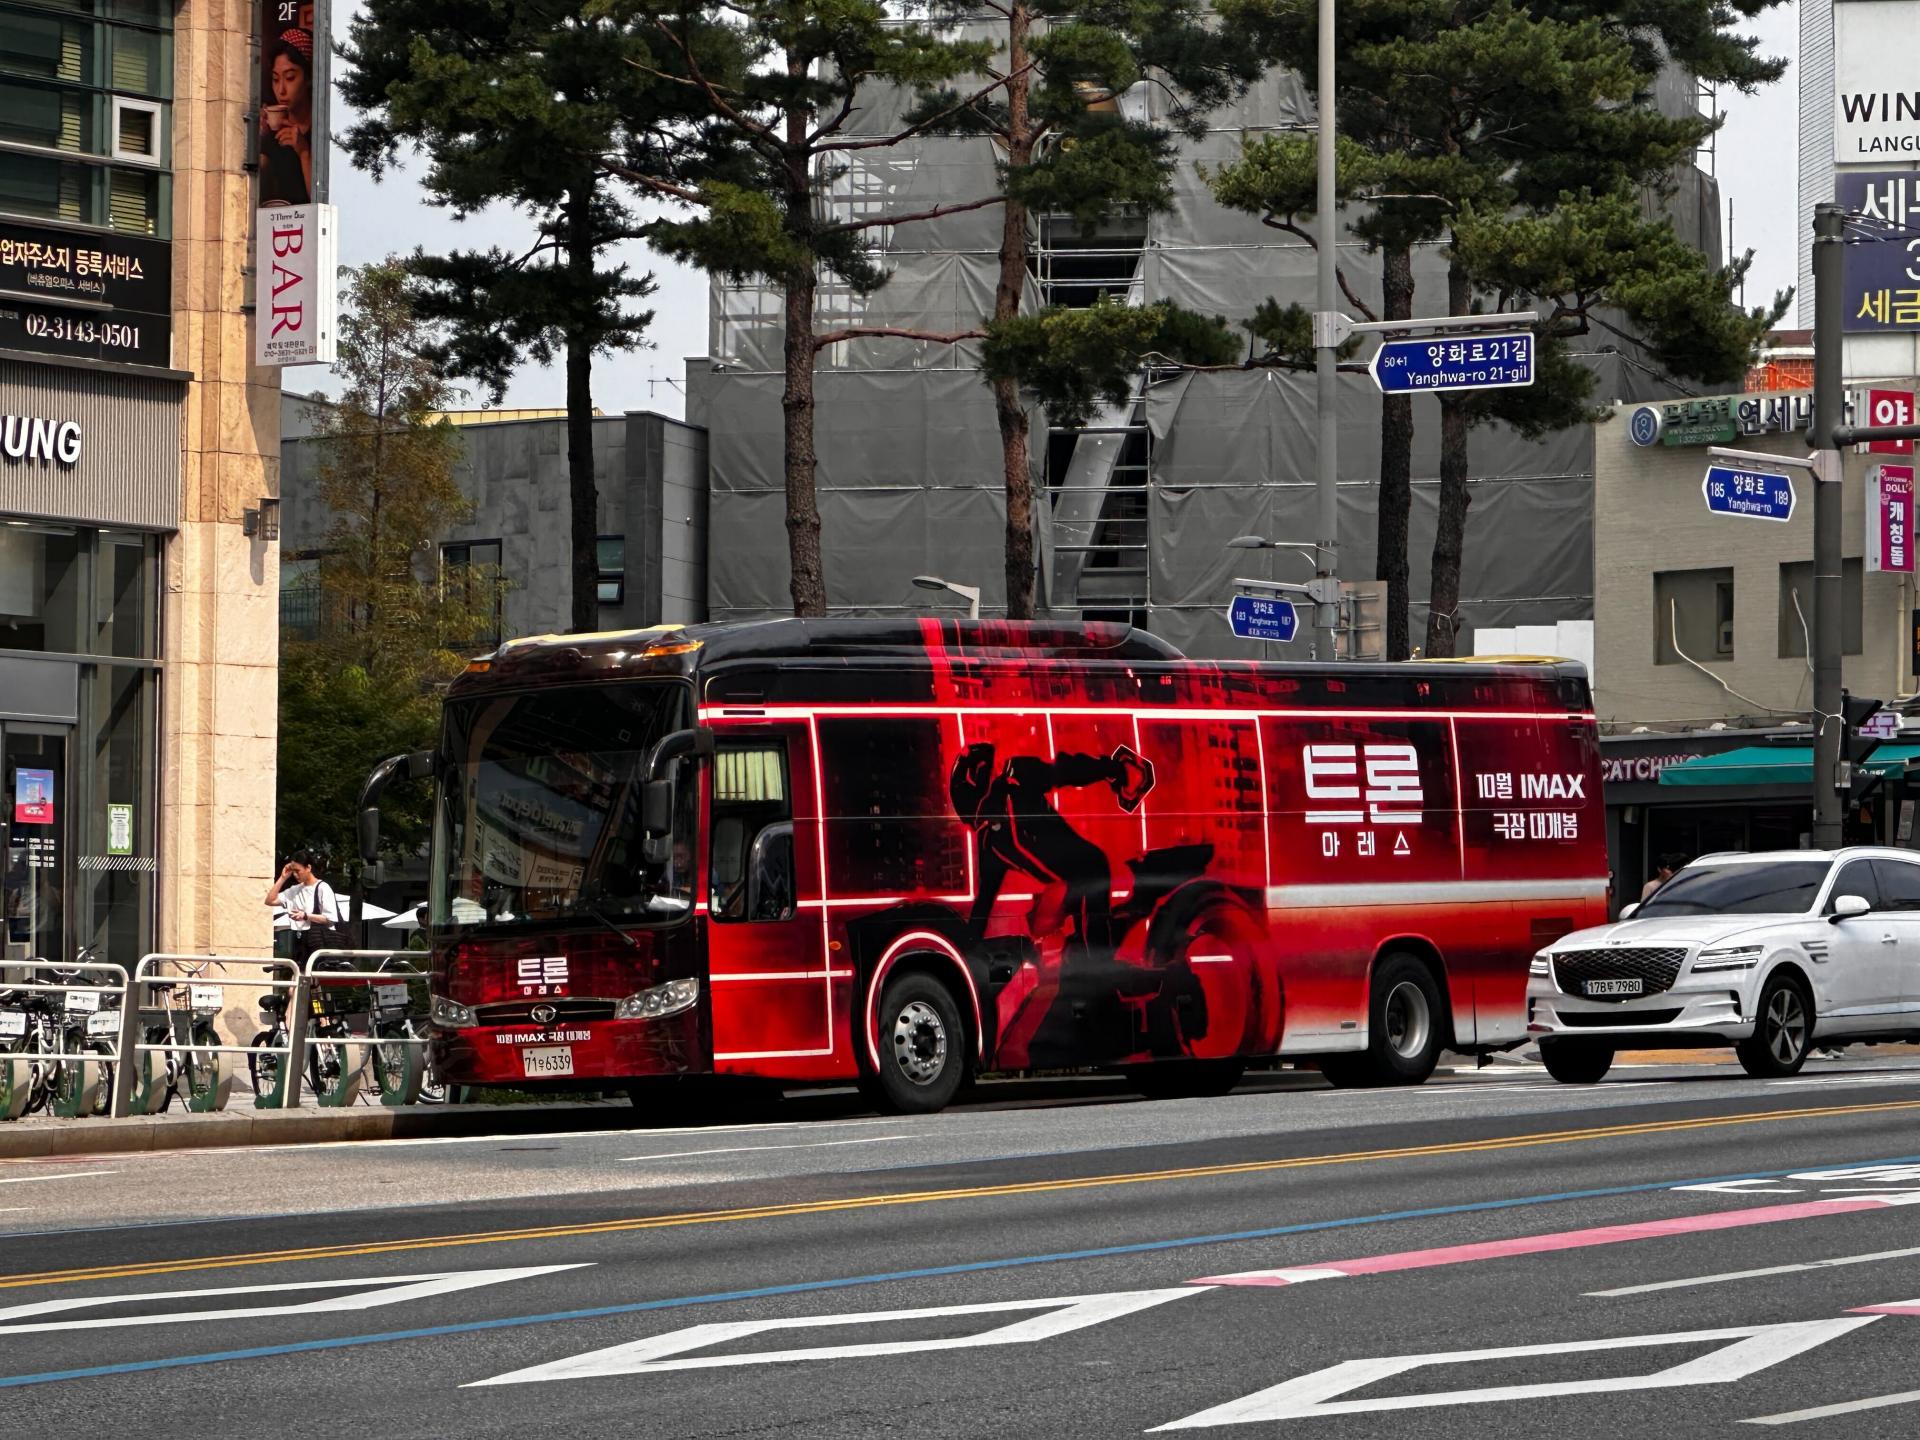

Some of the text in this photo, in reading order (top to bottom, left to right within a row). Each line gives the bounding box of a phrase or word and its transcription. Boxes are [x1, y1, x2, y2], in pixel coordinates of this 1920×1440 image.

[279, 2, 297, 21] 2F
[0, 239, 144, 281] 업자주소지 등록서비스
[272, 224, 304, 339] BAR
[26, 313, 140, 349] 02-3143-0501
[1407, 365, 1527, 387] Yanghwa-ro 21-gil
[0, 415, 81, 463] UNG
[1710, 482, 1725, 498] 185
[1733, 475, 1766, 496] 양화로
[1727, 496, 1772, 514] Yanghwa-ro
[1302, 744, 1424, 824] 트론
[1476, 773, 1586, 800] 10월 IMAX
[1493, 812, 1578, 839] 극장 대개봉
[517, 956, 569, 984] 트론
[514, 1032, 546, 1043] IMAX
